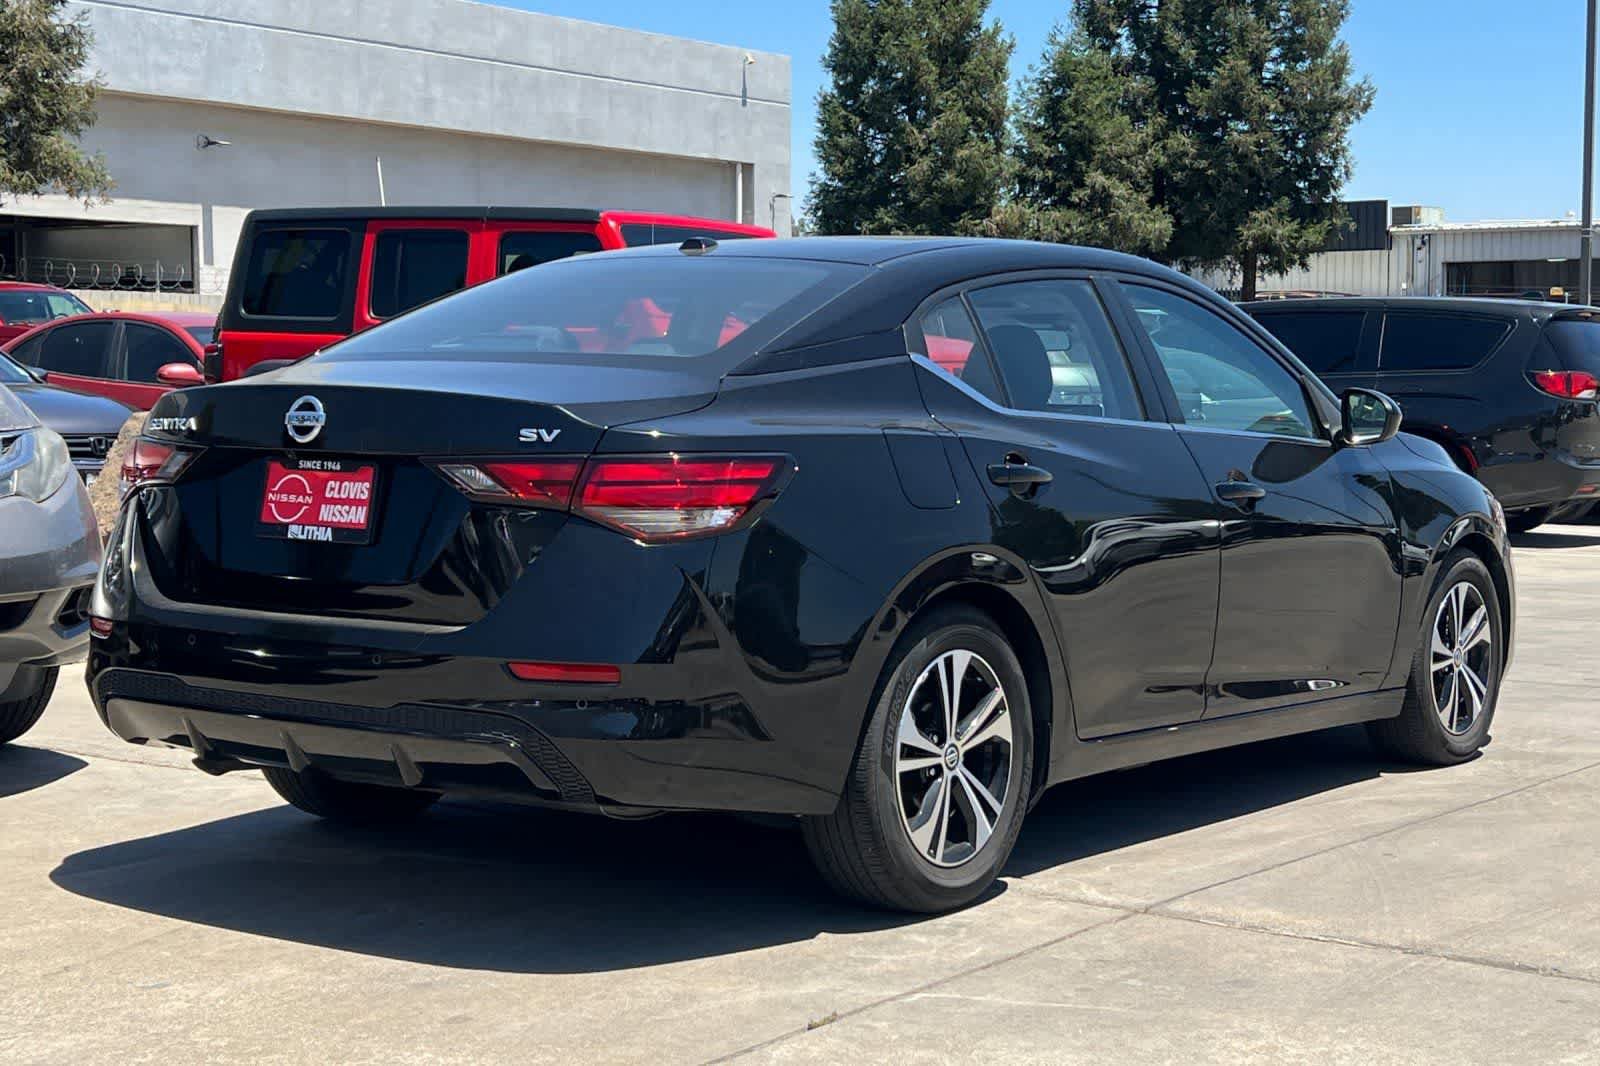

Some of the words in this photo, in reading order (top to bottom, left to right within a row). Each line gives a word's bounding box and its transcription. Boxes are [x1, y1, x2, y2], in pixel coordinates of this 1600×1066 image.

[518, 428, 561, 442] SV
[298, 460, 321, 469] SINCE
[323, 461, 341, 470] 1946
[325, 480, 370, 500] CLOVIS
[268, 493, 313, 504] NISSAN
[318, 503, 366, 523] NISSAN
[298, 526, 333, 541] LITHIA
